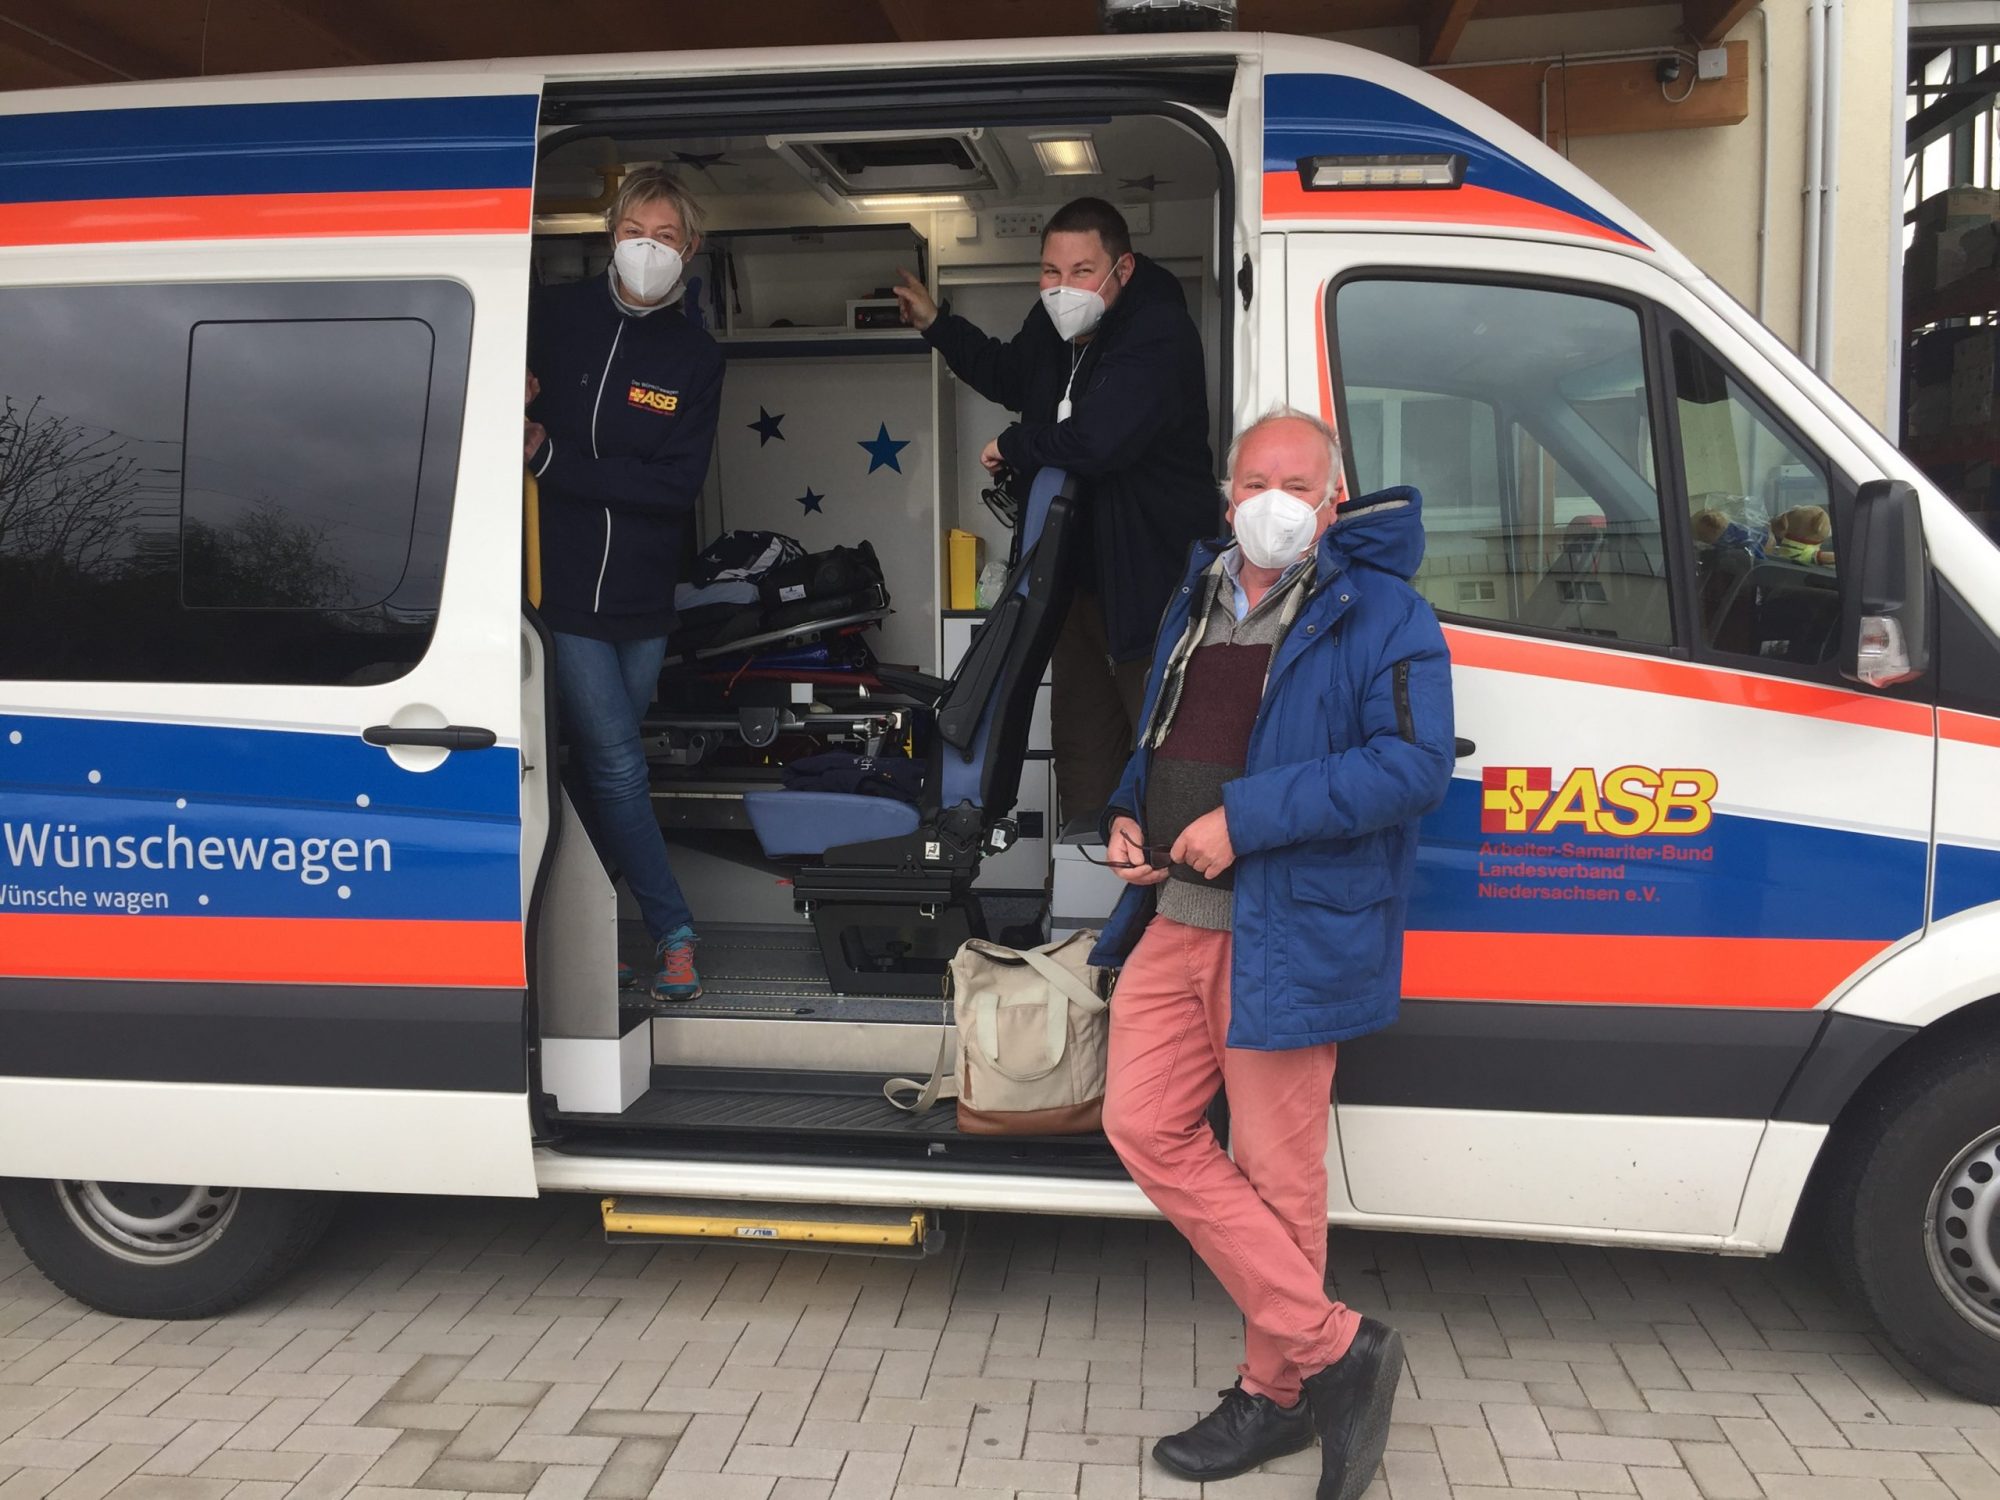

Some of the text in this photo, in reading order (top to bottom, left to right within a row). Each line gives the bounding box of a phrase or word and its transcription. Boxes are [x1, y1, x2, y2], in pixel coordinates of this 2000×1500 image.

[640, 390, 678, 411] ASB
[1531, 765, 1718, 838] ASB
[3, 823, 392, 885] Wünschewagen
[1479, 842, 1713, 861] Arbeiter-Samariter-Bund
[1479, 862, 1625, 880] Landesverband
[93, 891, 169, 914] wagen
[1478, 883, 1661, 902] Niedersachsen e.V.
